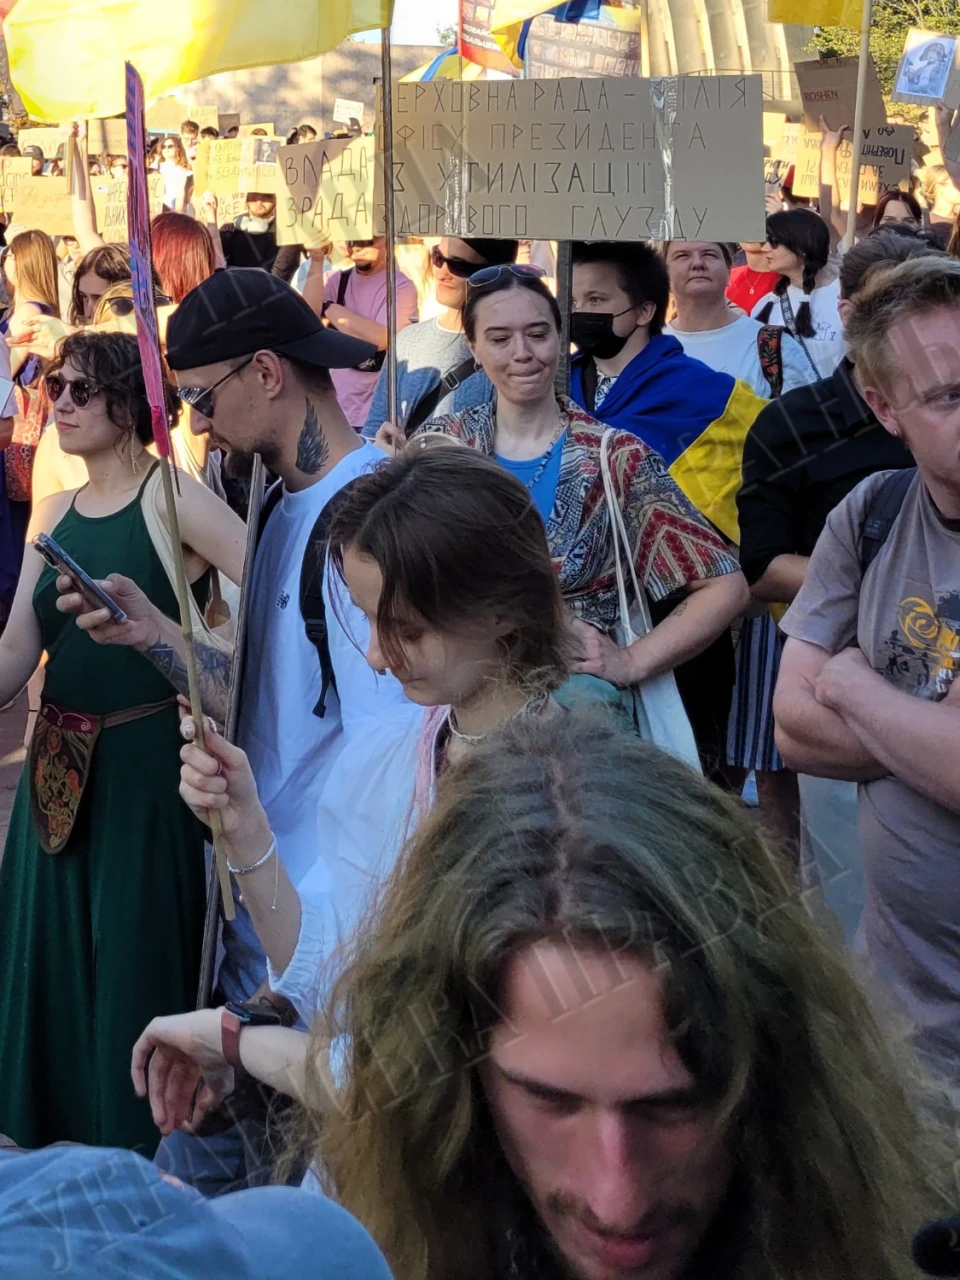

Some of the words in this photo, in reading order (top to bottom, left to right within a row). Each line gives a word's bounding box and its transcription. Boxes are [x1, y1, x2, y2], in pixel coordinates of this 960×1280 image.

[534, 79, 610, 114] РАДА
[653, 77, 746, 110] ІЛІЯ
[804, 89, 839, 103] ROSHEN
[491, 122, 707, 153] ПРЕЗИДЕНТА
[285, 146, 369, 186] ВЛАДА
[437, 161, 652, 197] УТИЛІЗАЦІЇ
[286, 191, 368, 230] ЗРАДА
